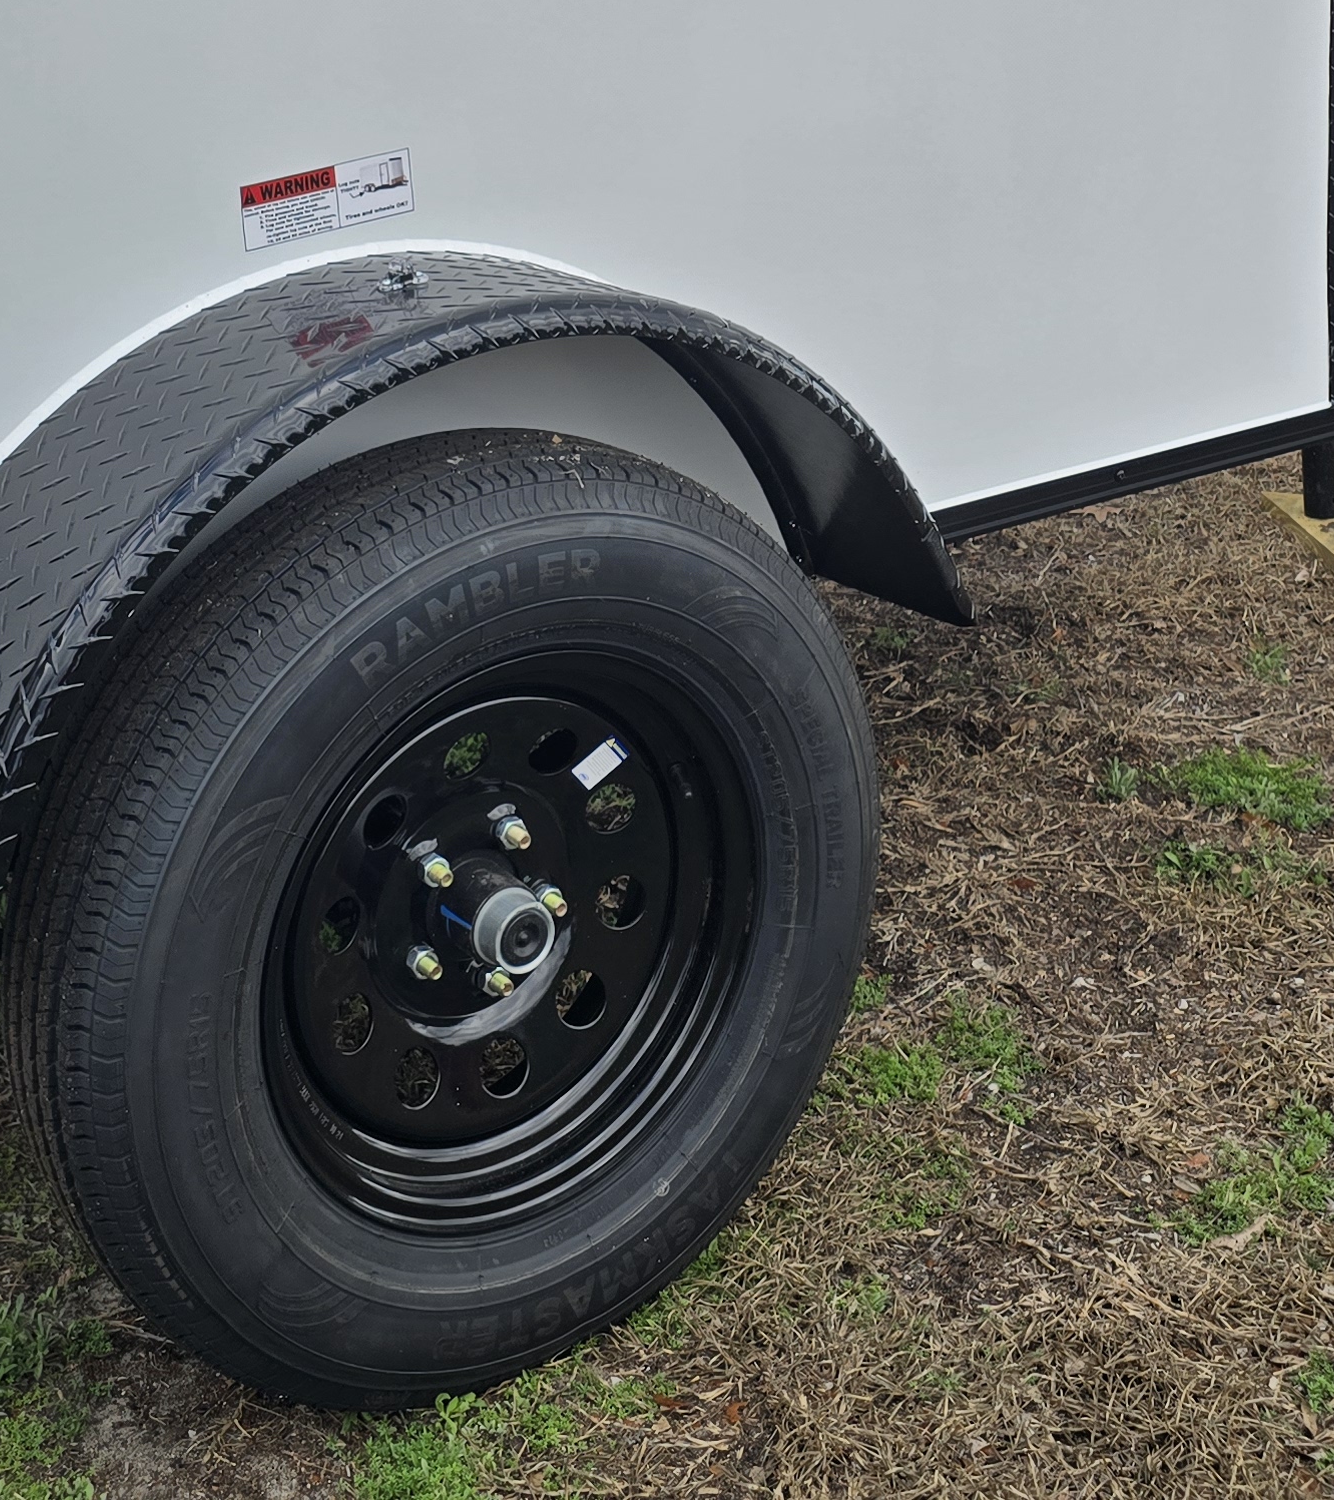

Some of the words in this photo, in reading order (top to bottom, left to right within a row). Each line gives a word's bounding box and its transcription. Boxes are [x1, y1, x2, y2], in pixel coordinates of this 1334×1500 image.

[260, 171, 331, 200] WARNING
[350, 548, 601, 690] RAMBLER
[788, 687, 835, 781] SPECIAL
[821, 784, 845, 890] TRAILER
[432, 1150, 743, 1361] TASKMASTER
